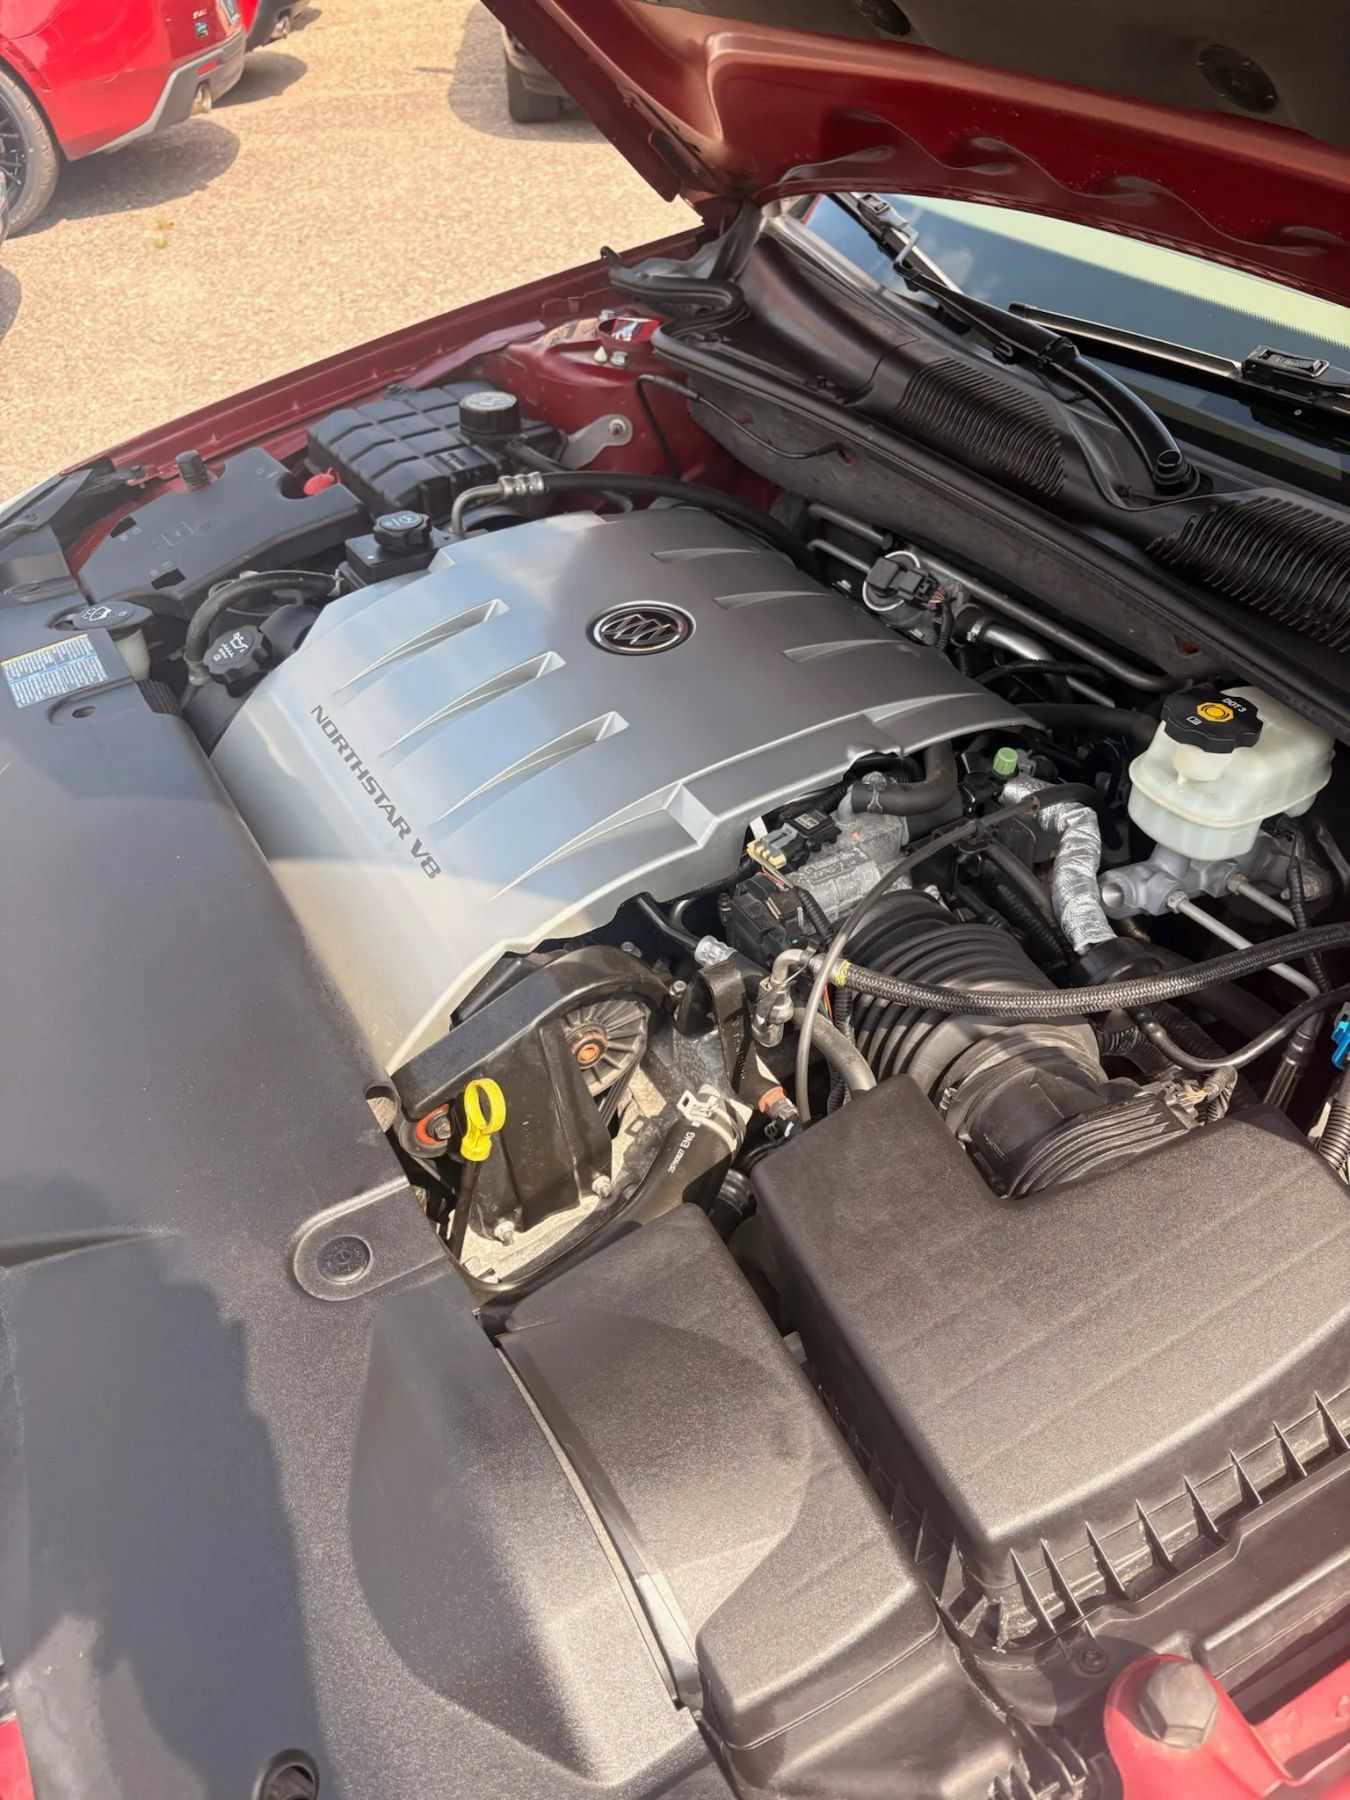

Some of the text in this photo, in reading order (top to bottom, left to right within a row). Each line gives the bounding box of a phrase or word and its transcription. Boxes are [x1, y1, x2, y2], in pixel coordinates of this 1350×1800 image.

[1222, 697, 1248, 713] DOT 3
[310, 704, 442, 880] NORTHSTAR V8
[680, 1131, 696, 1149] ENG
